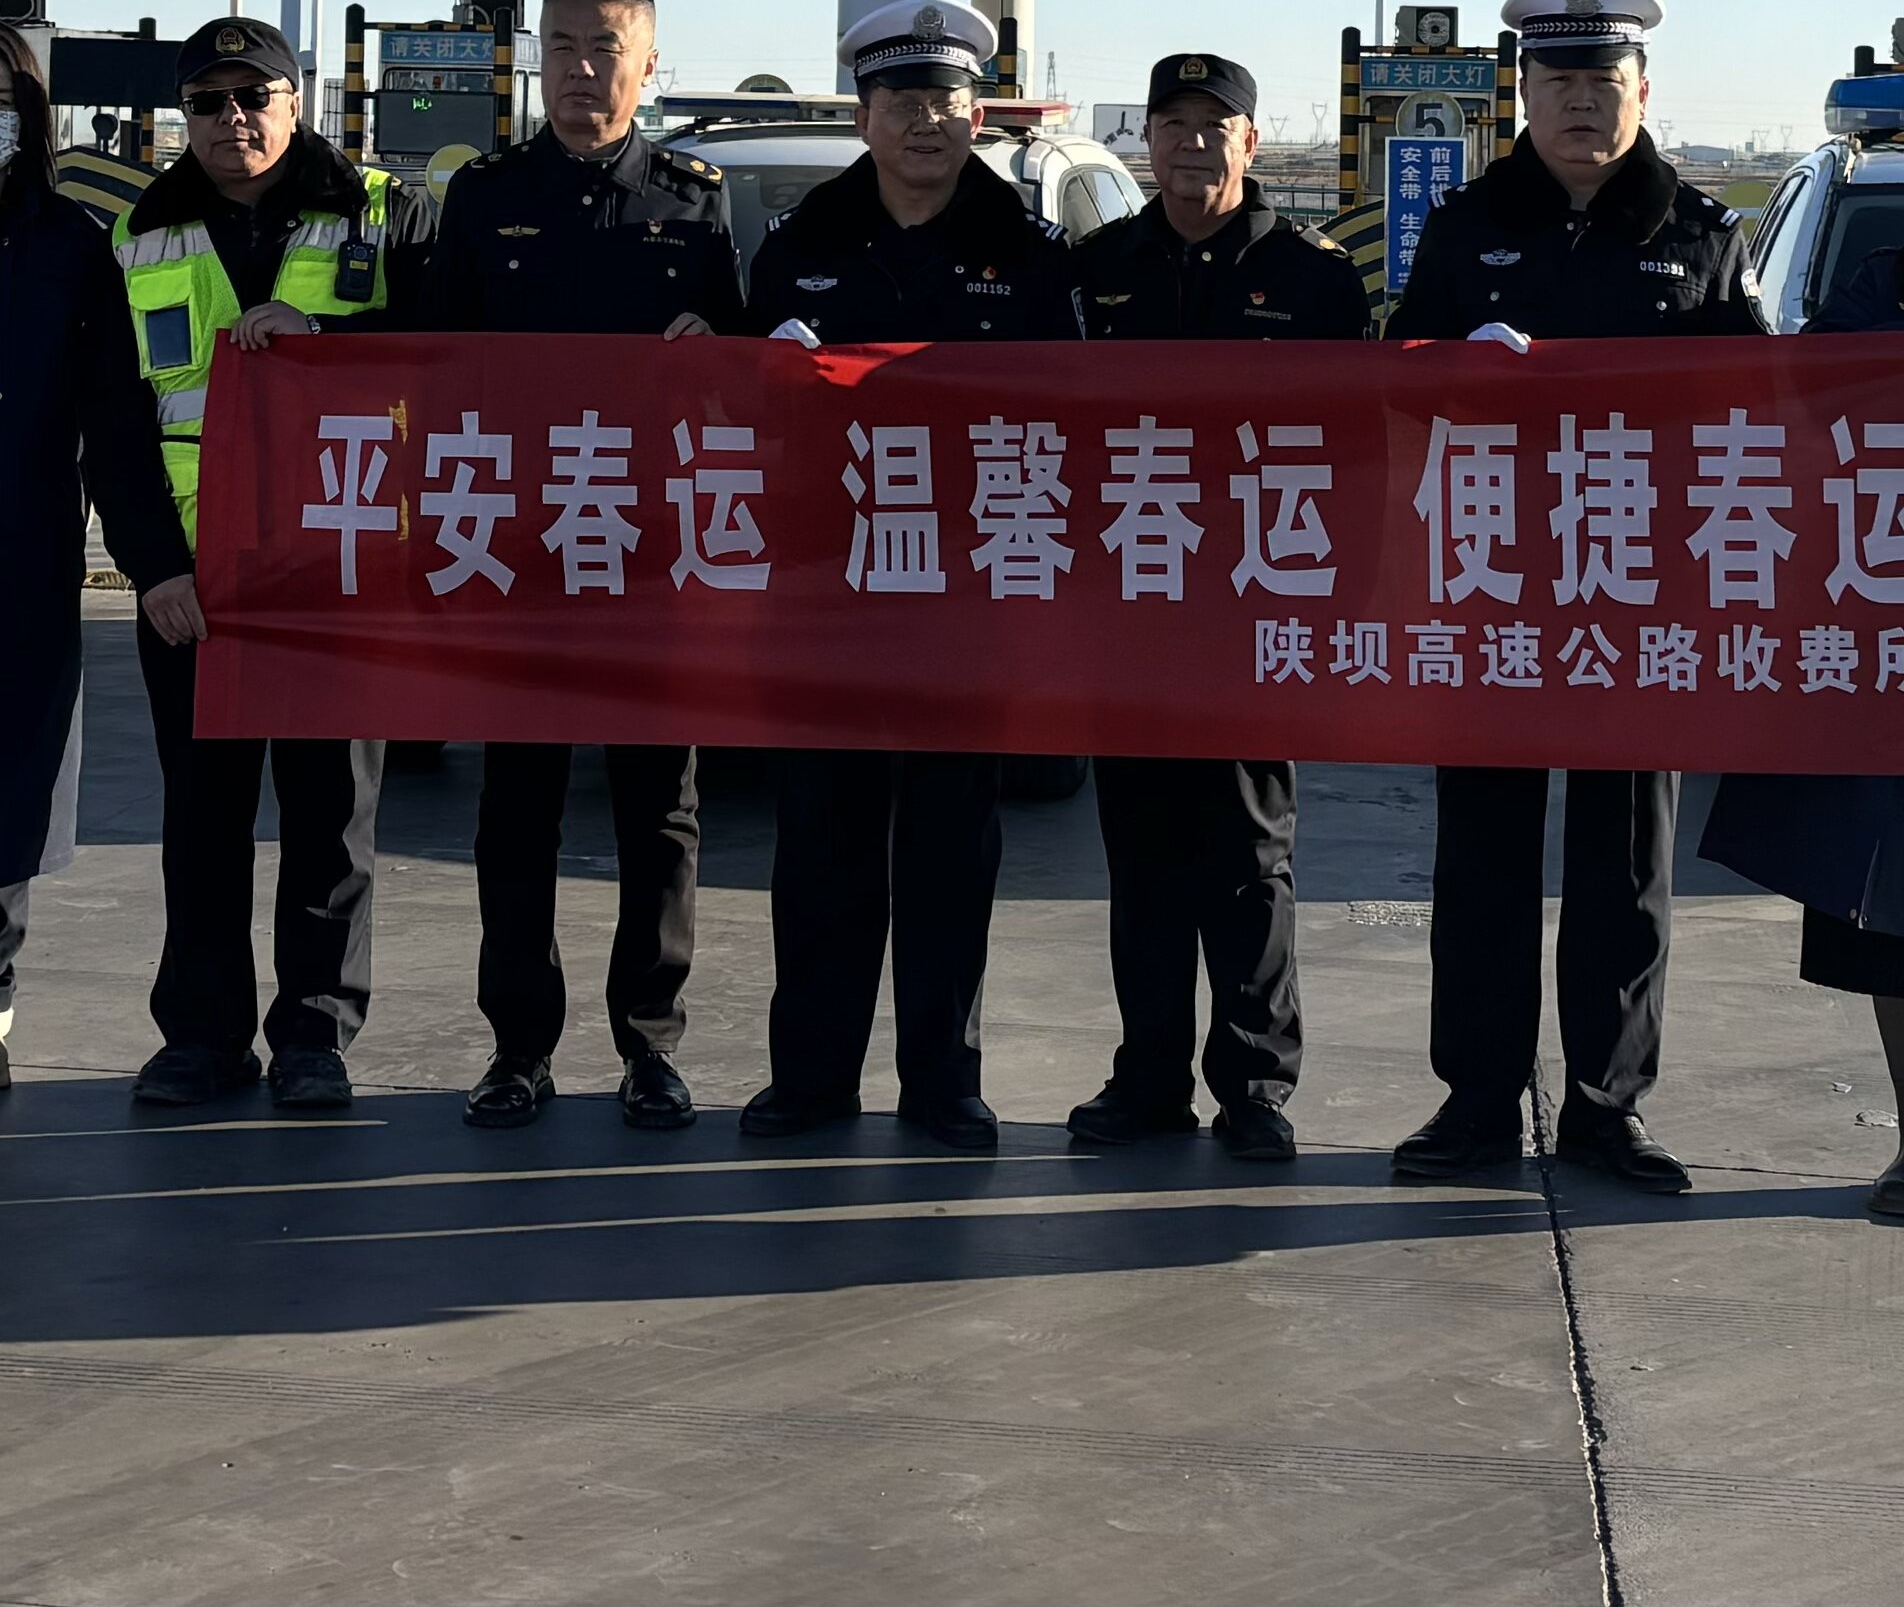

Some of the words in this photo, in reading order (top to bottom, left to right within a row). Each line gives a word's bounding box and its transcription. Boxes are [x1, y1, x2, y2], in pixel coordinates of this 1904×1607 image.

[1370, 63, 1486, 86] 请关闭大灯
[1415, 102, 1446, 137] 5
[301, 410, 772, 596] 平安春运
[841, 415, 1338, 601] 温馨春运
